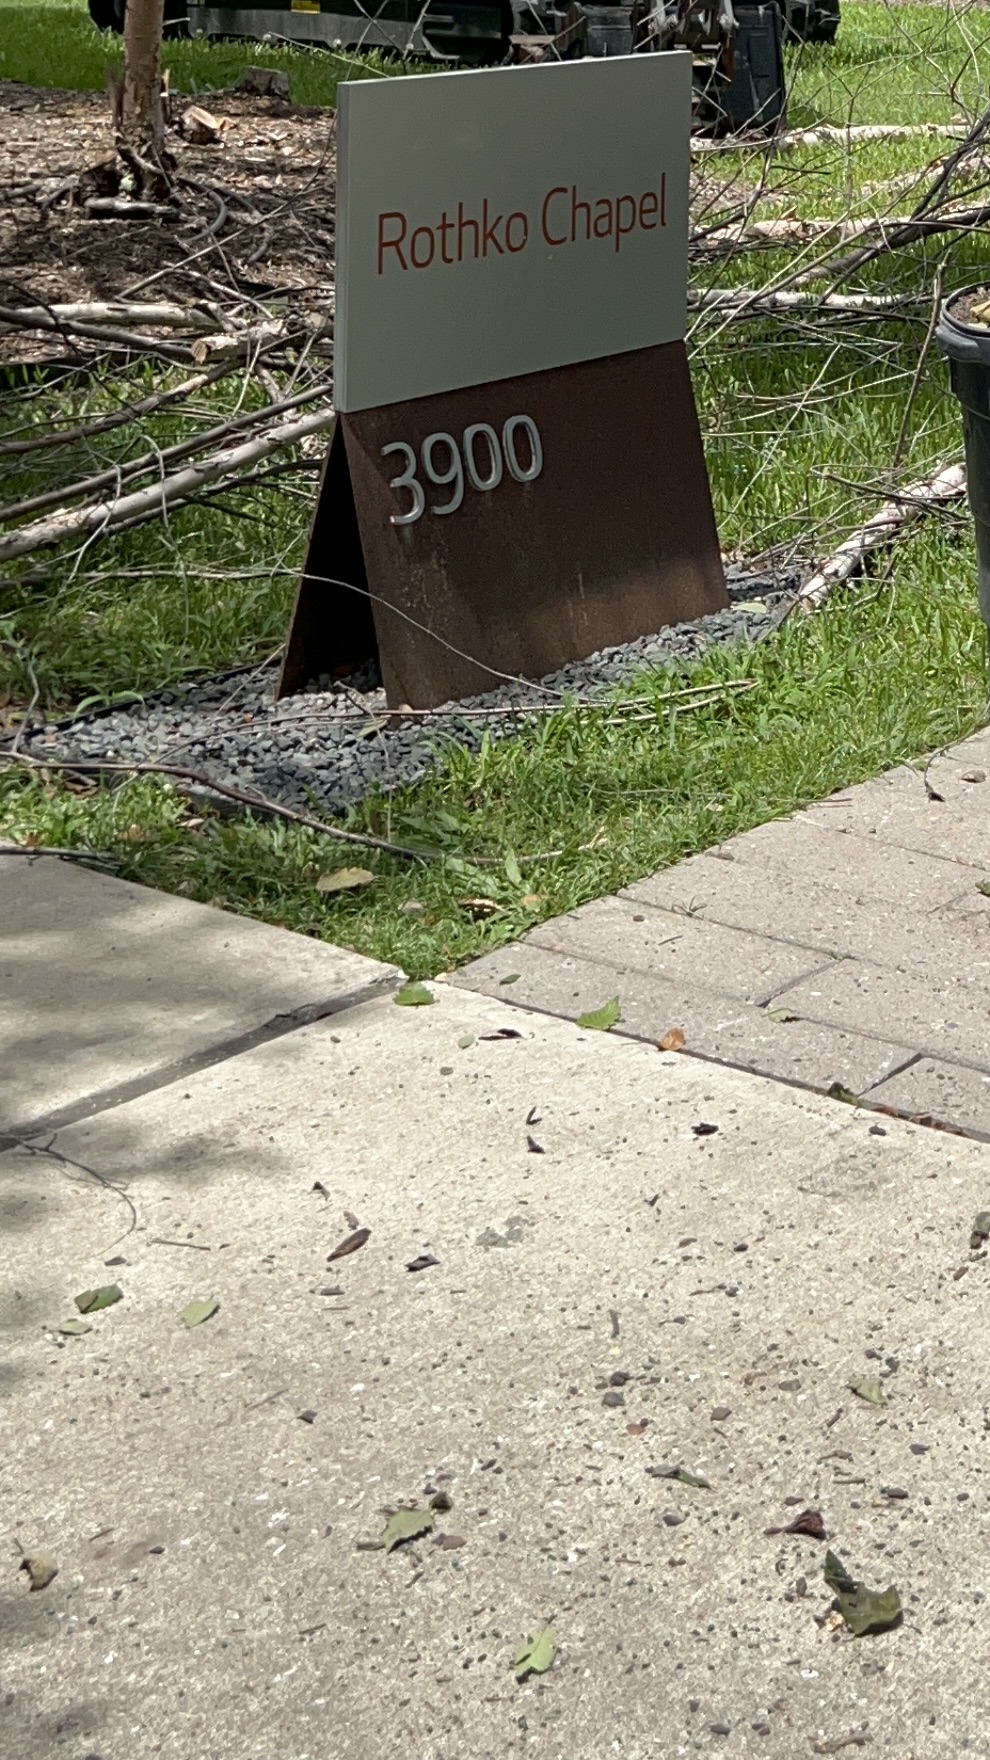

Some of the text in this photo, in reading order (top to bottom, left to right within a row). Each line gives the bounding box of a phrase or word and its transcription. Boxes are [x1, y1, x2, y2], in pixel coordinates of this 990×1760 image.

[376, 172, 667, 275] Rothko Chapel
[381, 414, 544, 526] 3900
